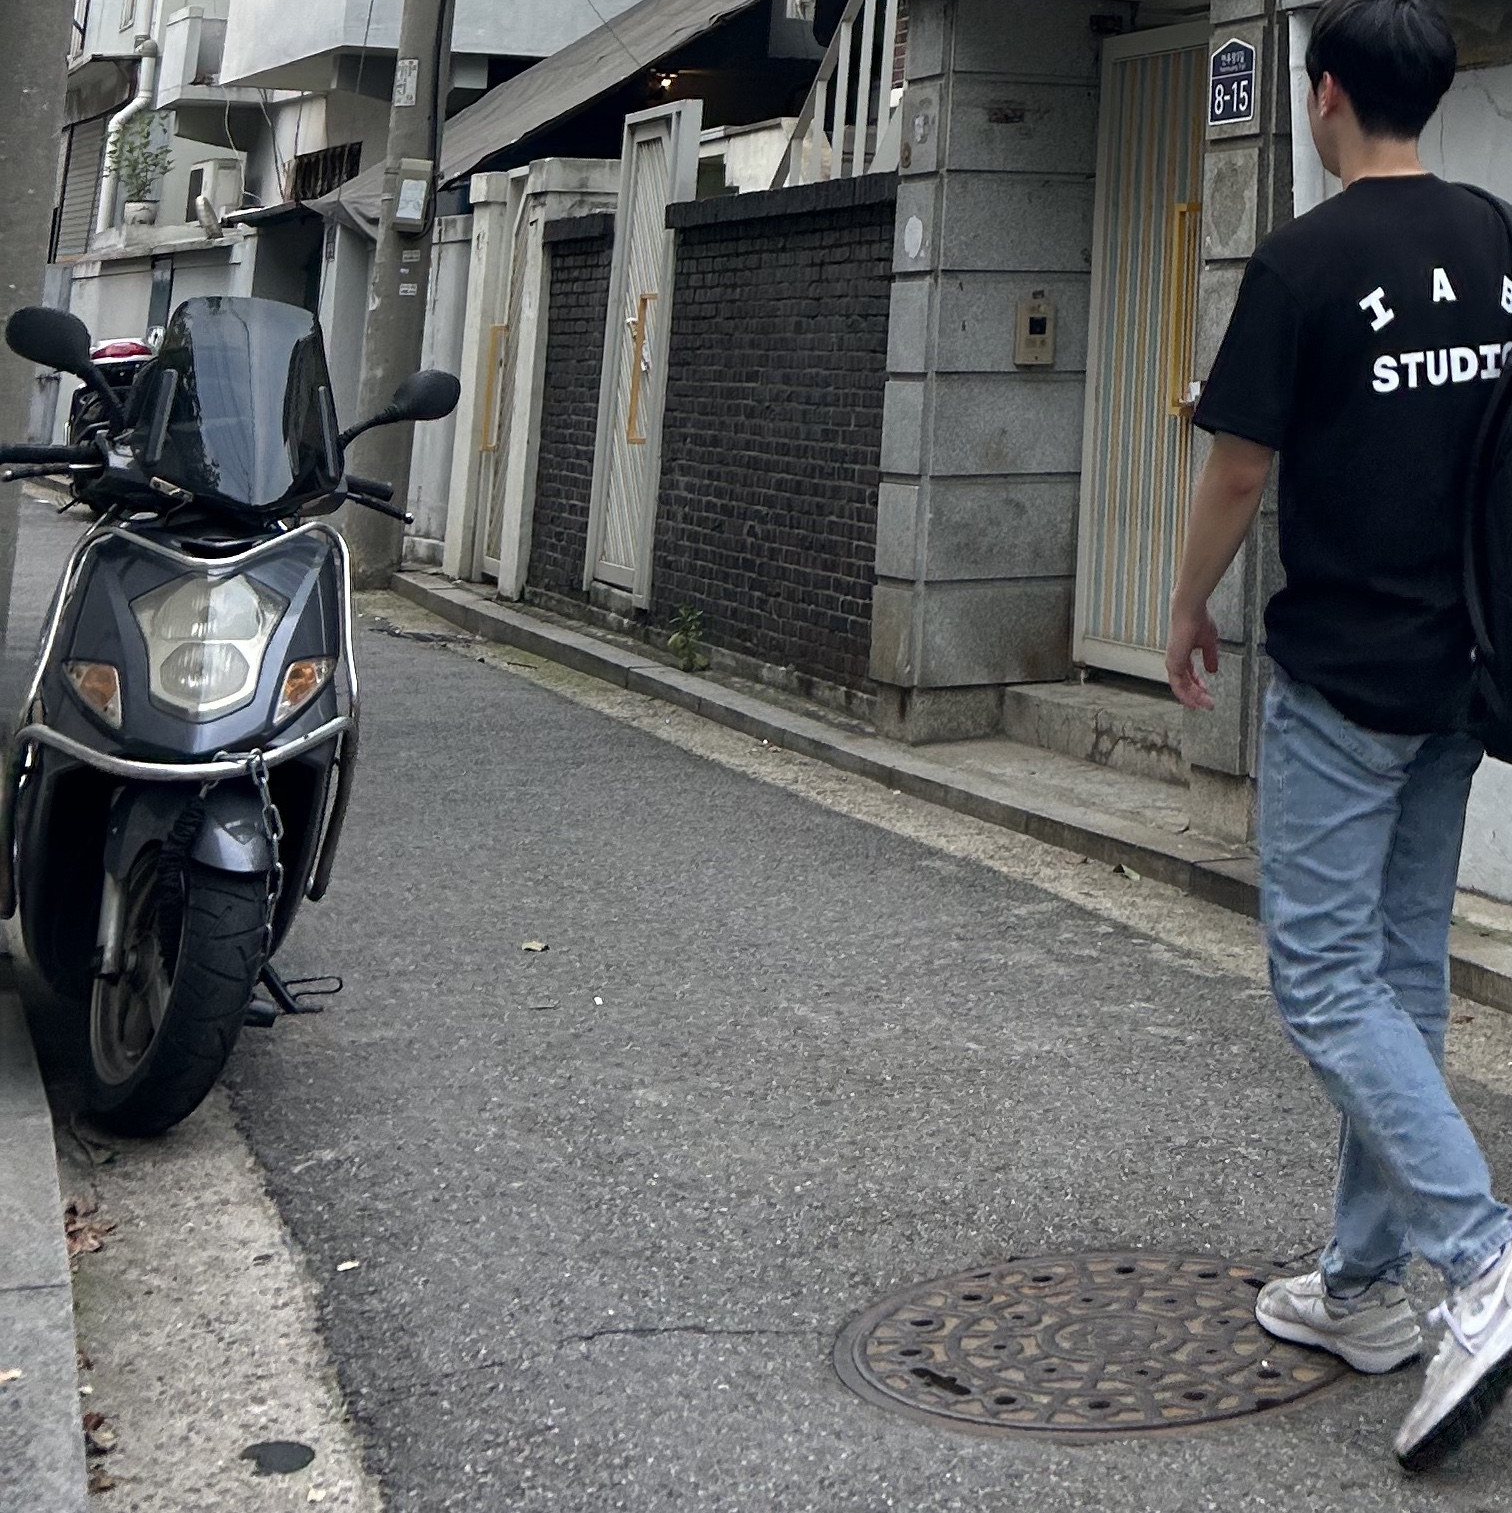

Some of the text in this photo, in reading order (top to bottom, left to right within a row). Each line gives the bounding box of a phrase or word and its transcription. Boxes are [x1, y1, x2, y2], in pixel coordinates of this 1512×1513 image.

[1213, 79, 1249, 116] 8-15
[1358, 286, 1395, 332] I
[1432, 267, 1457, 302] A
